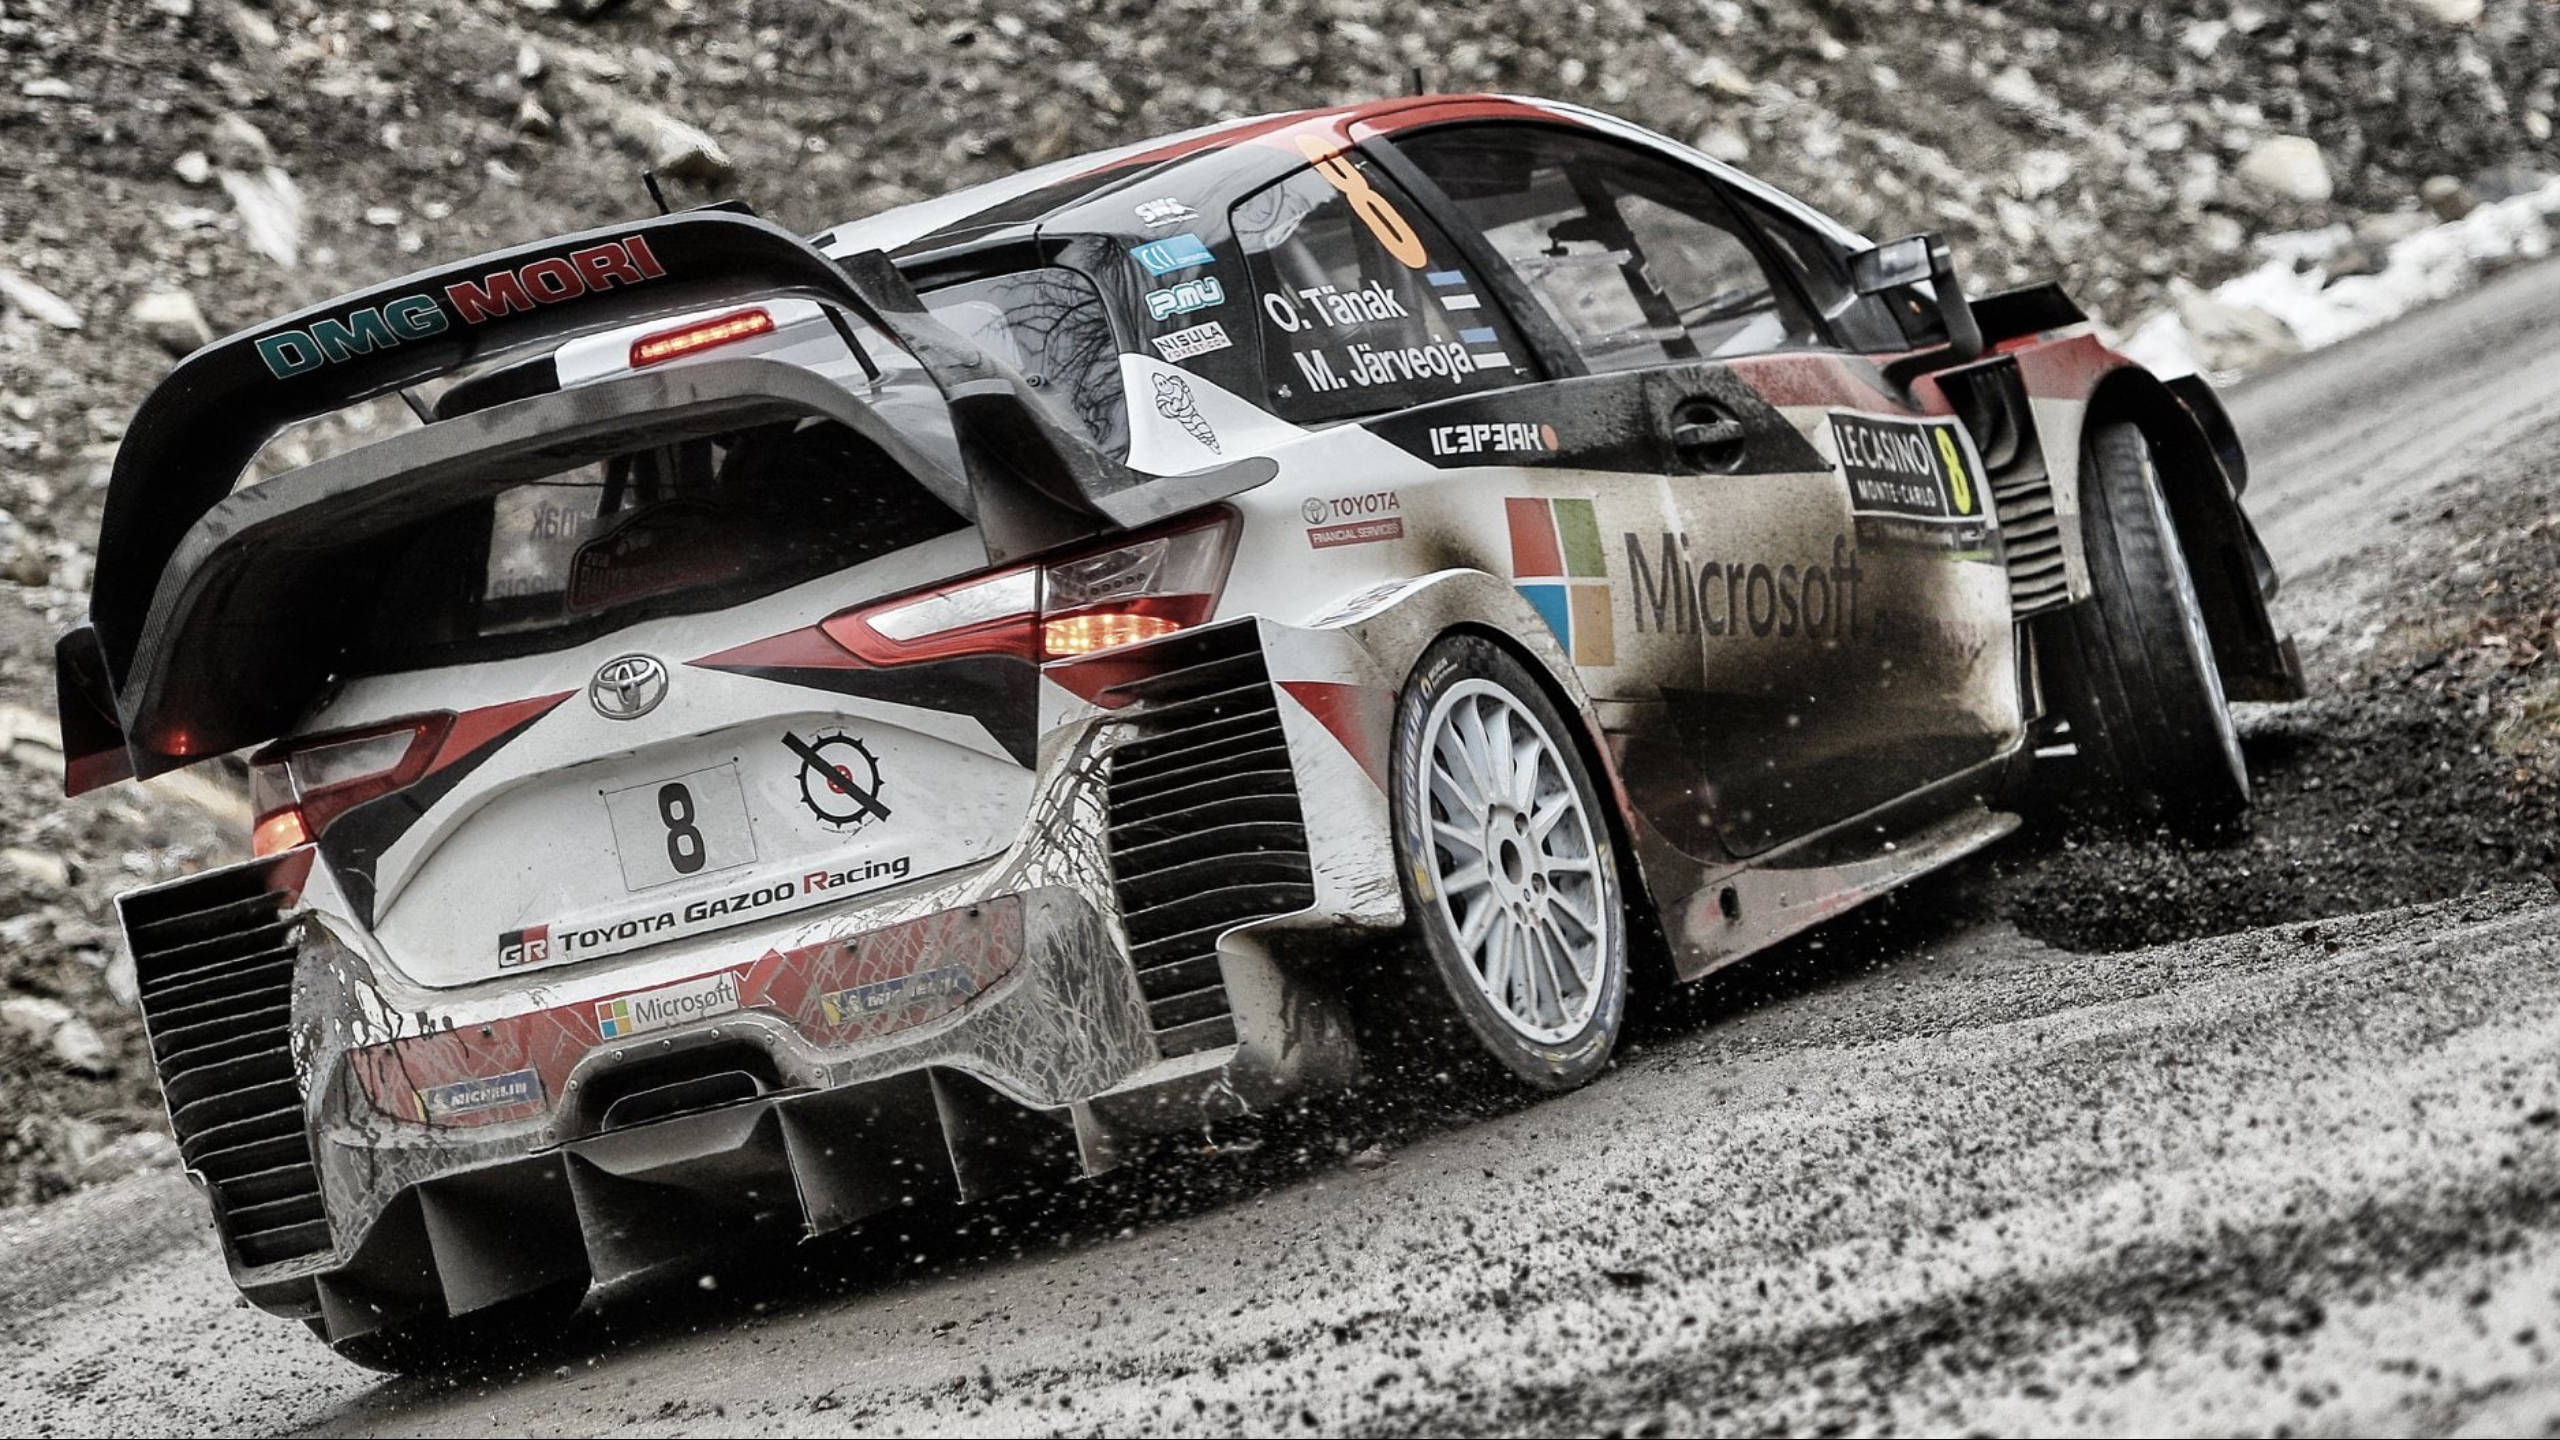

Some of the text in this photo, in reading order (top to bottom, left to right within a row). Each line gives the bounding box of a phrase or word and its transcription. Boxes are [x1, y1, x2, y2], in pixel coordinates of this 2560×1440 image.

[1295, 133, 1428, 269] 8
[254, 235, 667, 380] DMG MORI
[1263, 280, 1409, 333] O. Tänak
[1156, 325, 1223, 352] NISULA
[1293, 334, 1476, 393] M. Järveoja
[1835, 424, 1930, 476] LE CASINO
[1934, 427, 1972, 515] 8
[1312, 522, 1400, 544] FINANCIAL SERVICES
[1330, 491, 1401, 518] TOYOTA
[1624, 532, 1864, 638] Microsoft
[658, 782, 706, 875] 8
[501, 855, 911, 966] GR TOYOTA GAZOO Racing
[635, 981, 735, 1023] Microsoft
